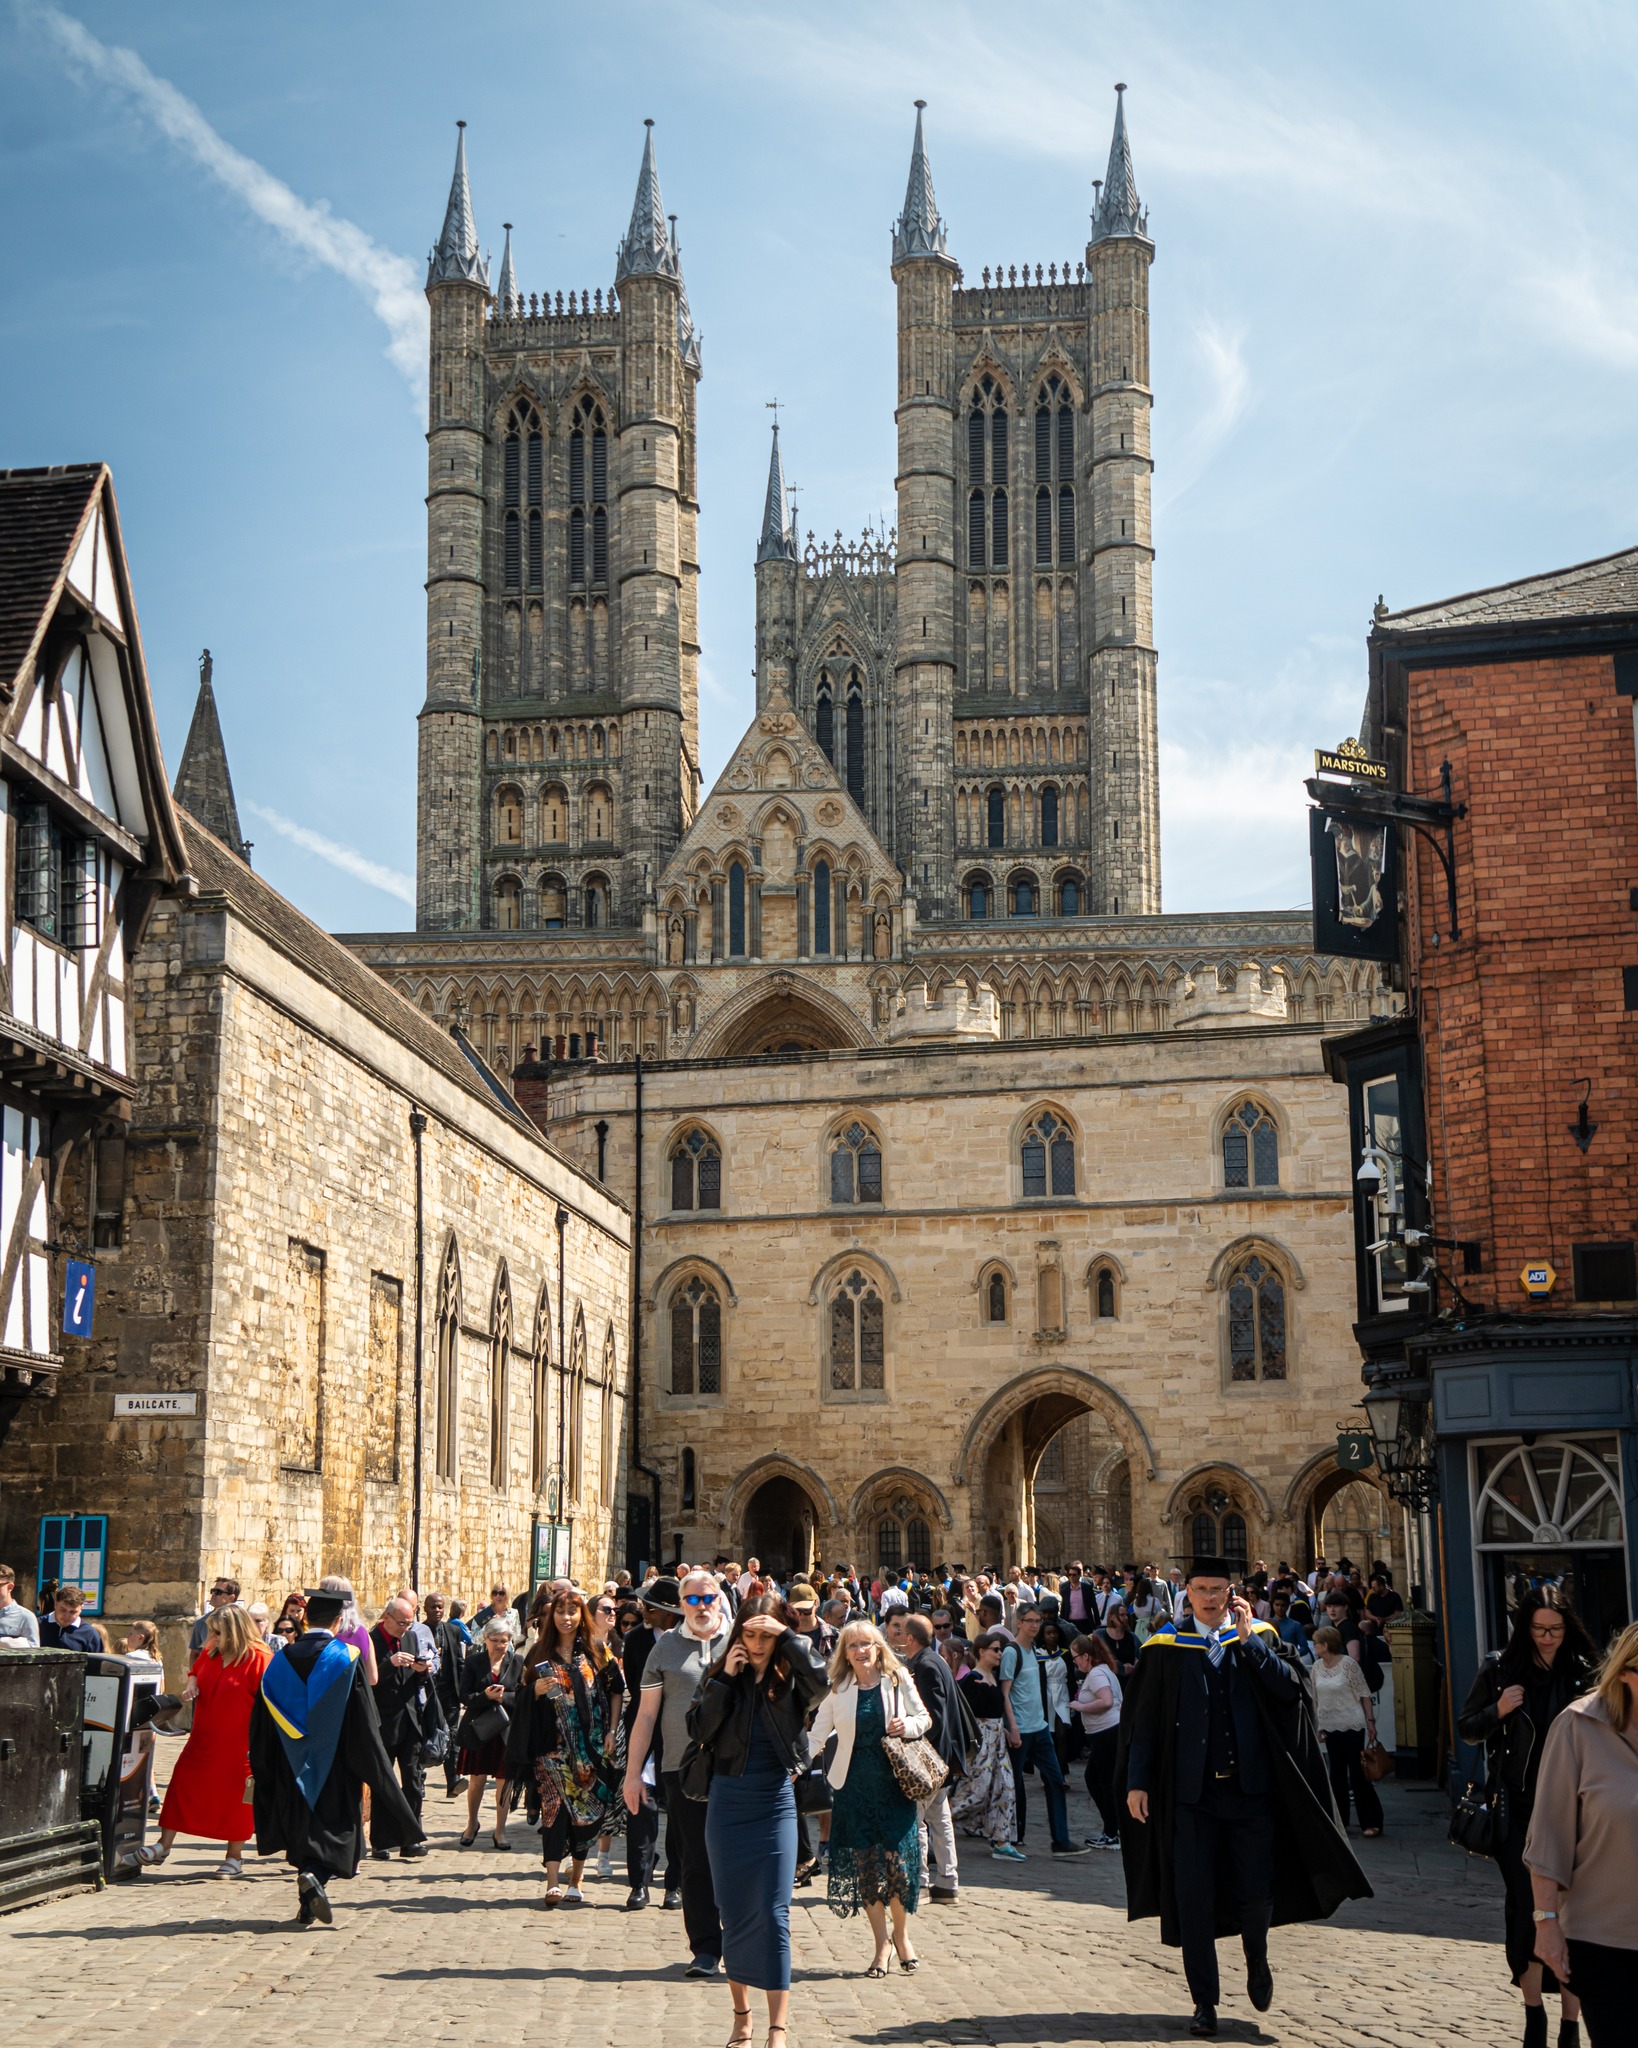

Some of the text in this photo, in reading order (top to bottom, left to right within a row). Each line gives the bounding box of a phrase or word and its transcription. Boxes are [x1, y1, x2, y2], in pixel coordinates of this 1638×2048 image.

[1322, 755, 1387, 778] MARSTON'S
[1528, 1271, 1547, 1282] ADT
[1350, 1442, 1360, 1460] 2
